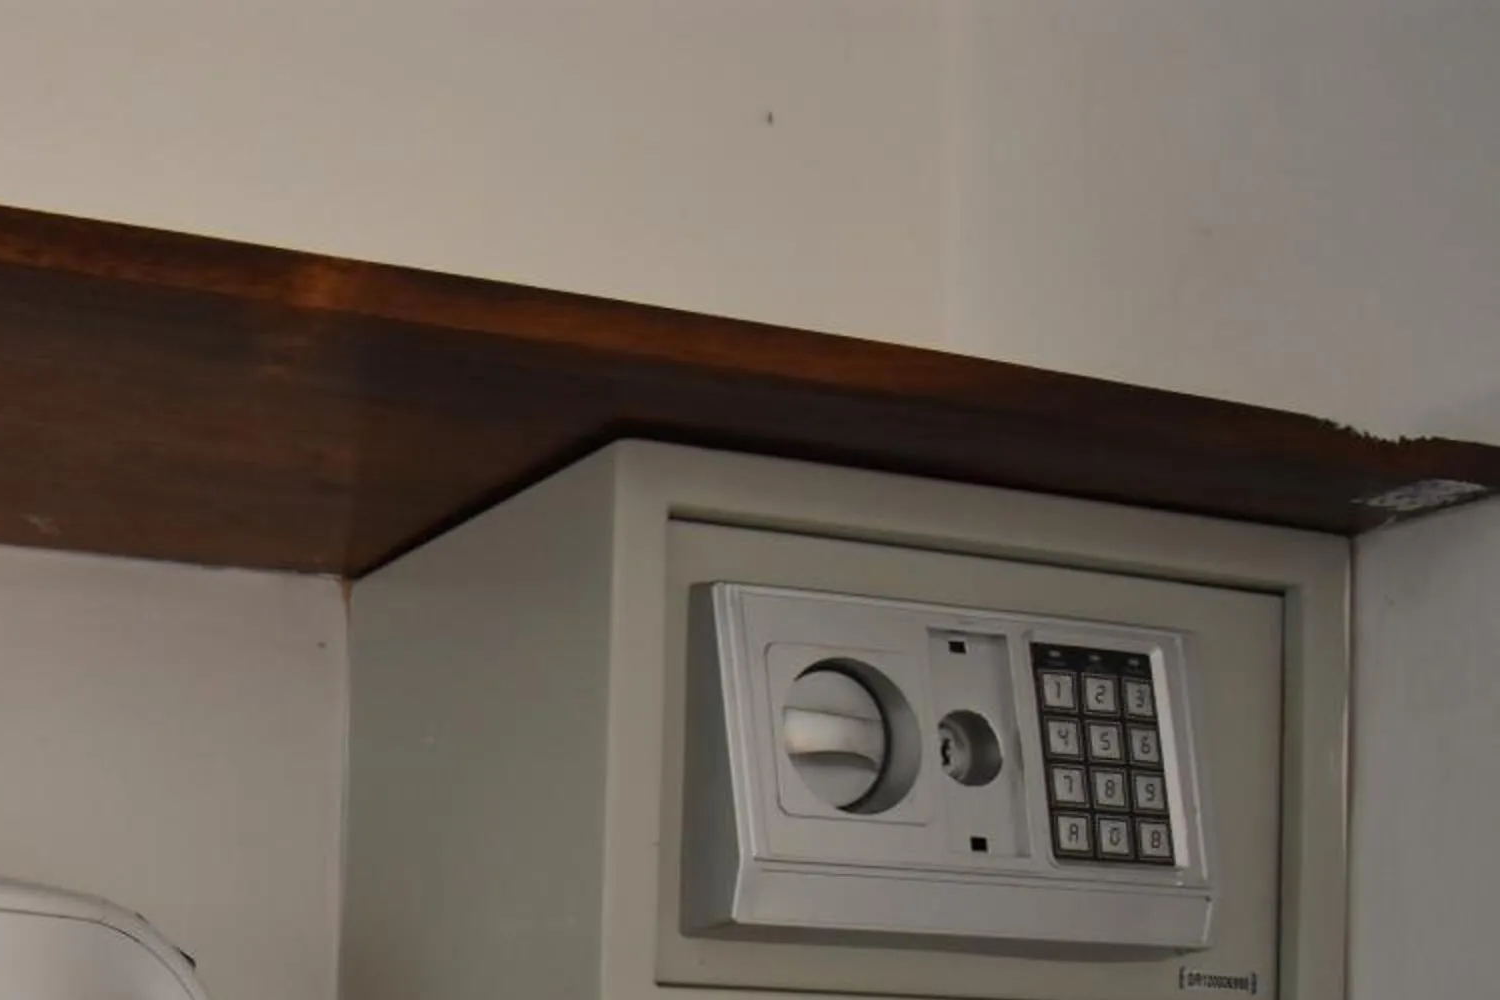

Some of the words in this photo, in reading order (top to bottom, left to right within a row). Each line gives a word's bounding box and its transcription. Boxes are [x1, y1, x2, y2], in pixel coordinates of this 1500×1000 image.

[1095, 684, 1106, 704] 2
[1057, 727, 1069, 747] 4
[1100, 731, 1111, 751] 5
[1140, 736, 1151, 754] 6
[1063, 775, 1073, 794] 7
[1104, 779, 1115, 798] 8
[1145, 783, 1156, 801] 9
[1068, 823, 1079, 842] A
